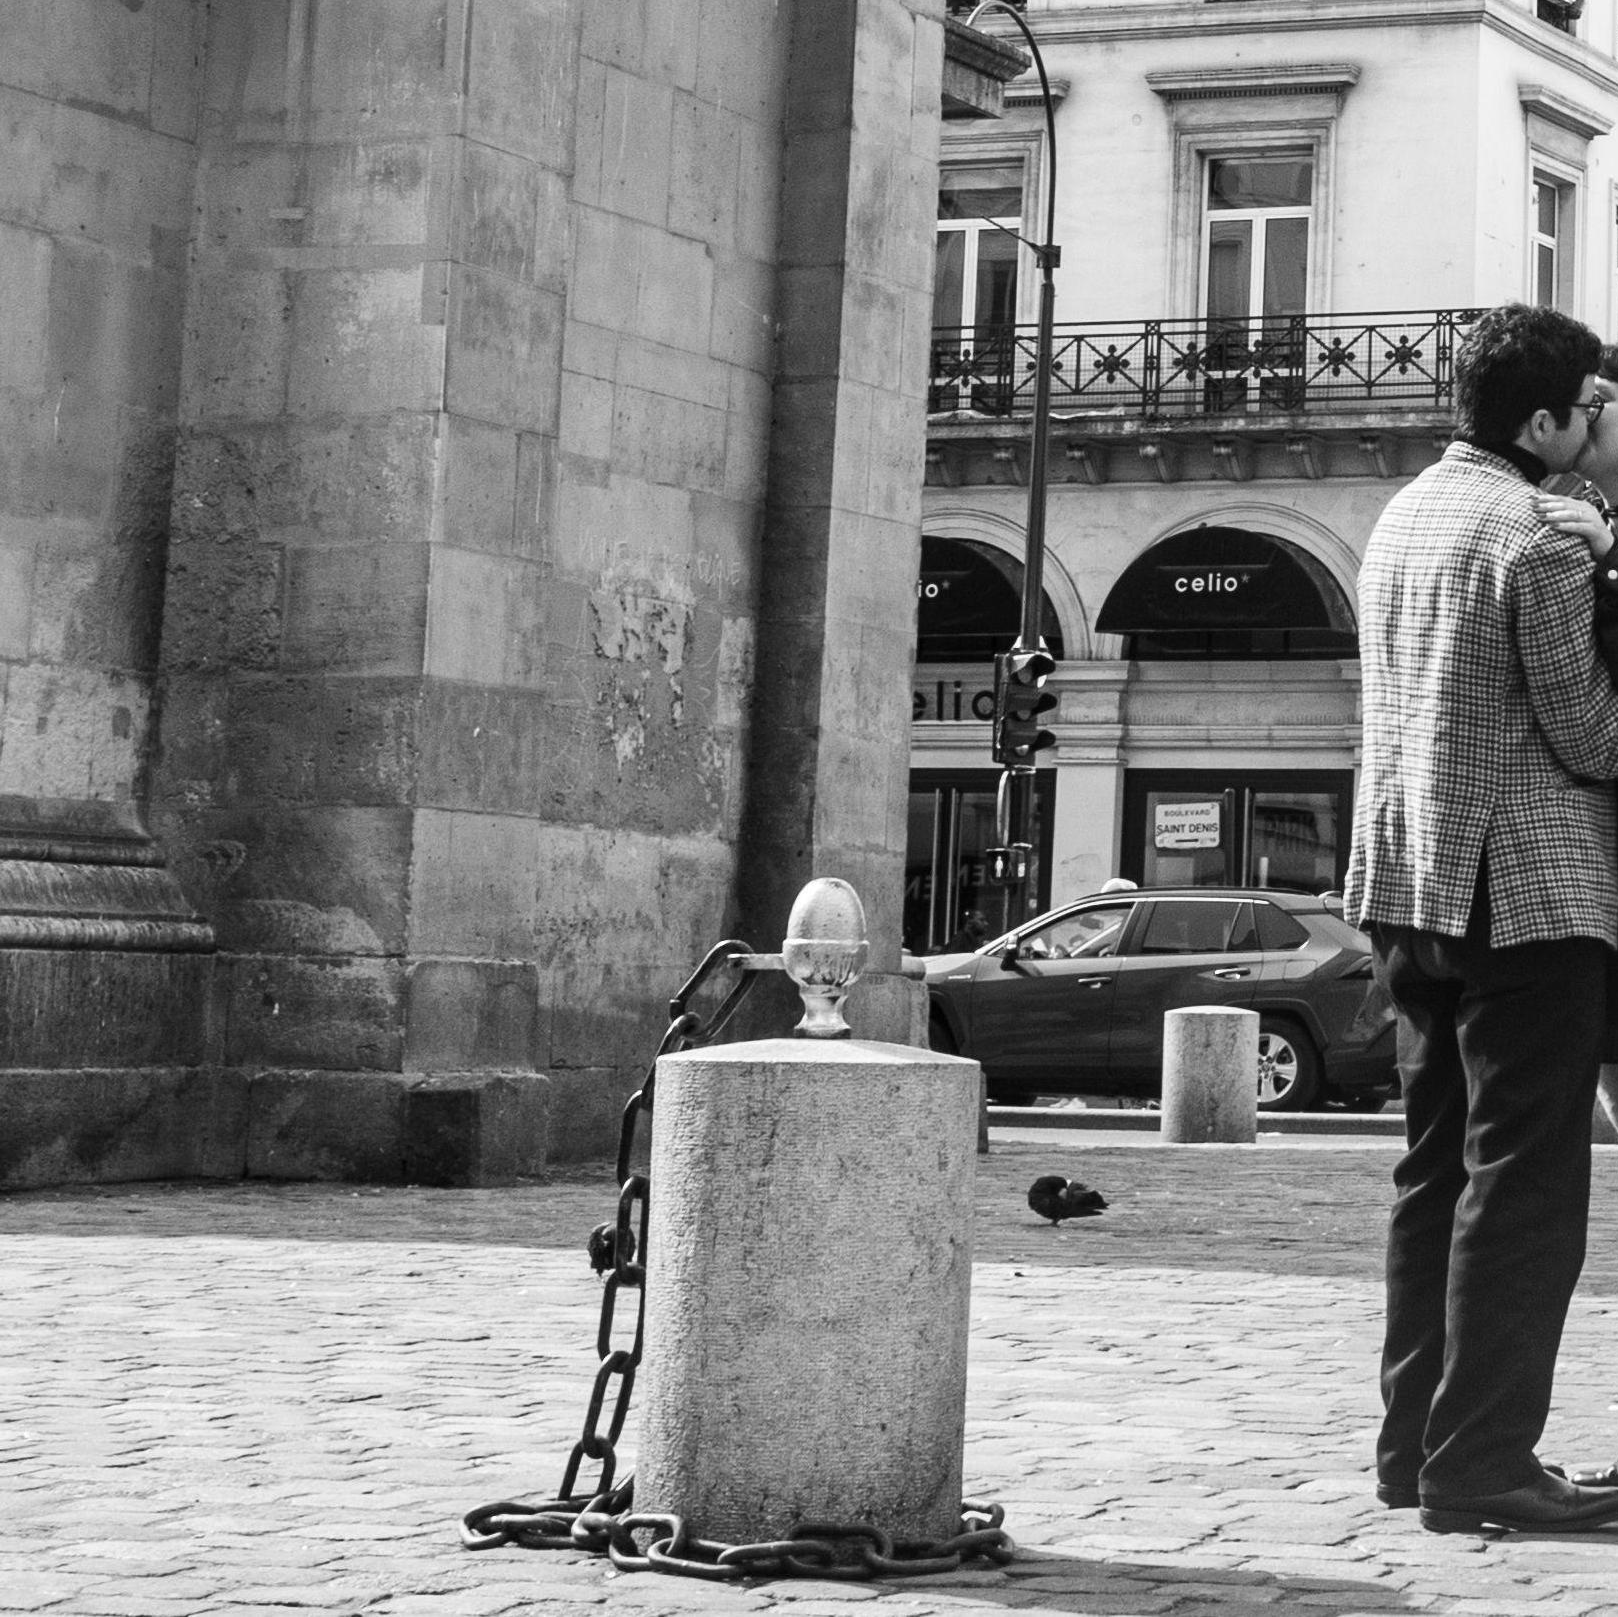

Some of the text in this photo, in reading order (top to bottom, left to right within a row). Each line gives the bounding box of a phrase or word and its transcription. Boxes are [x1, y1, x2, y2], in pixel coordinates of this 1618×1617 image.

[1174, 572, 1239, 593] celio
[912, 680, 995, 722] elio
[1156, 822, 1219, 835] SAINT DENIS
